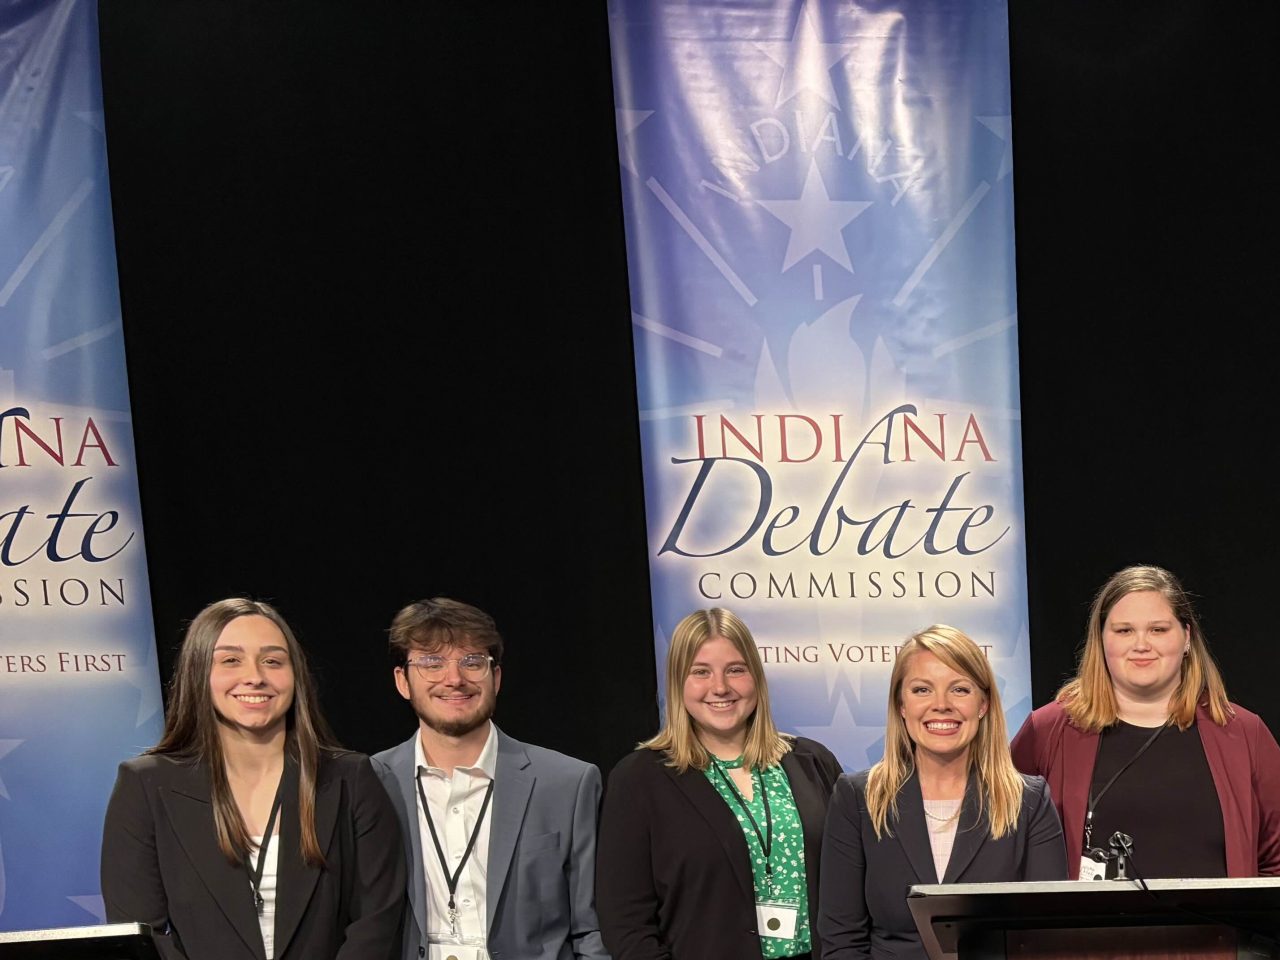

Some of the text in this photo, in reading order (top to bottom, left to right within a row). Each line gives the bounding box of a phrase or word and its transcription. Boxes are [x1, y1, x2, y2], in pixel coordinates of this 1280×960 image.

[692, 403, 998, 464] INDIANA
[656, 454, 1012, 560] Debate
[697, 569, 997, 600] COMMISSION
[58, 652, 126, 672] FIRST
